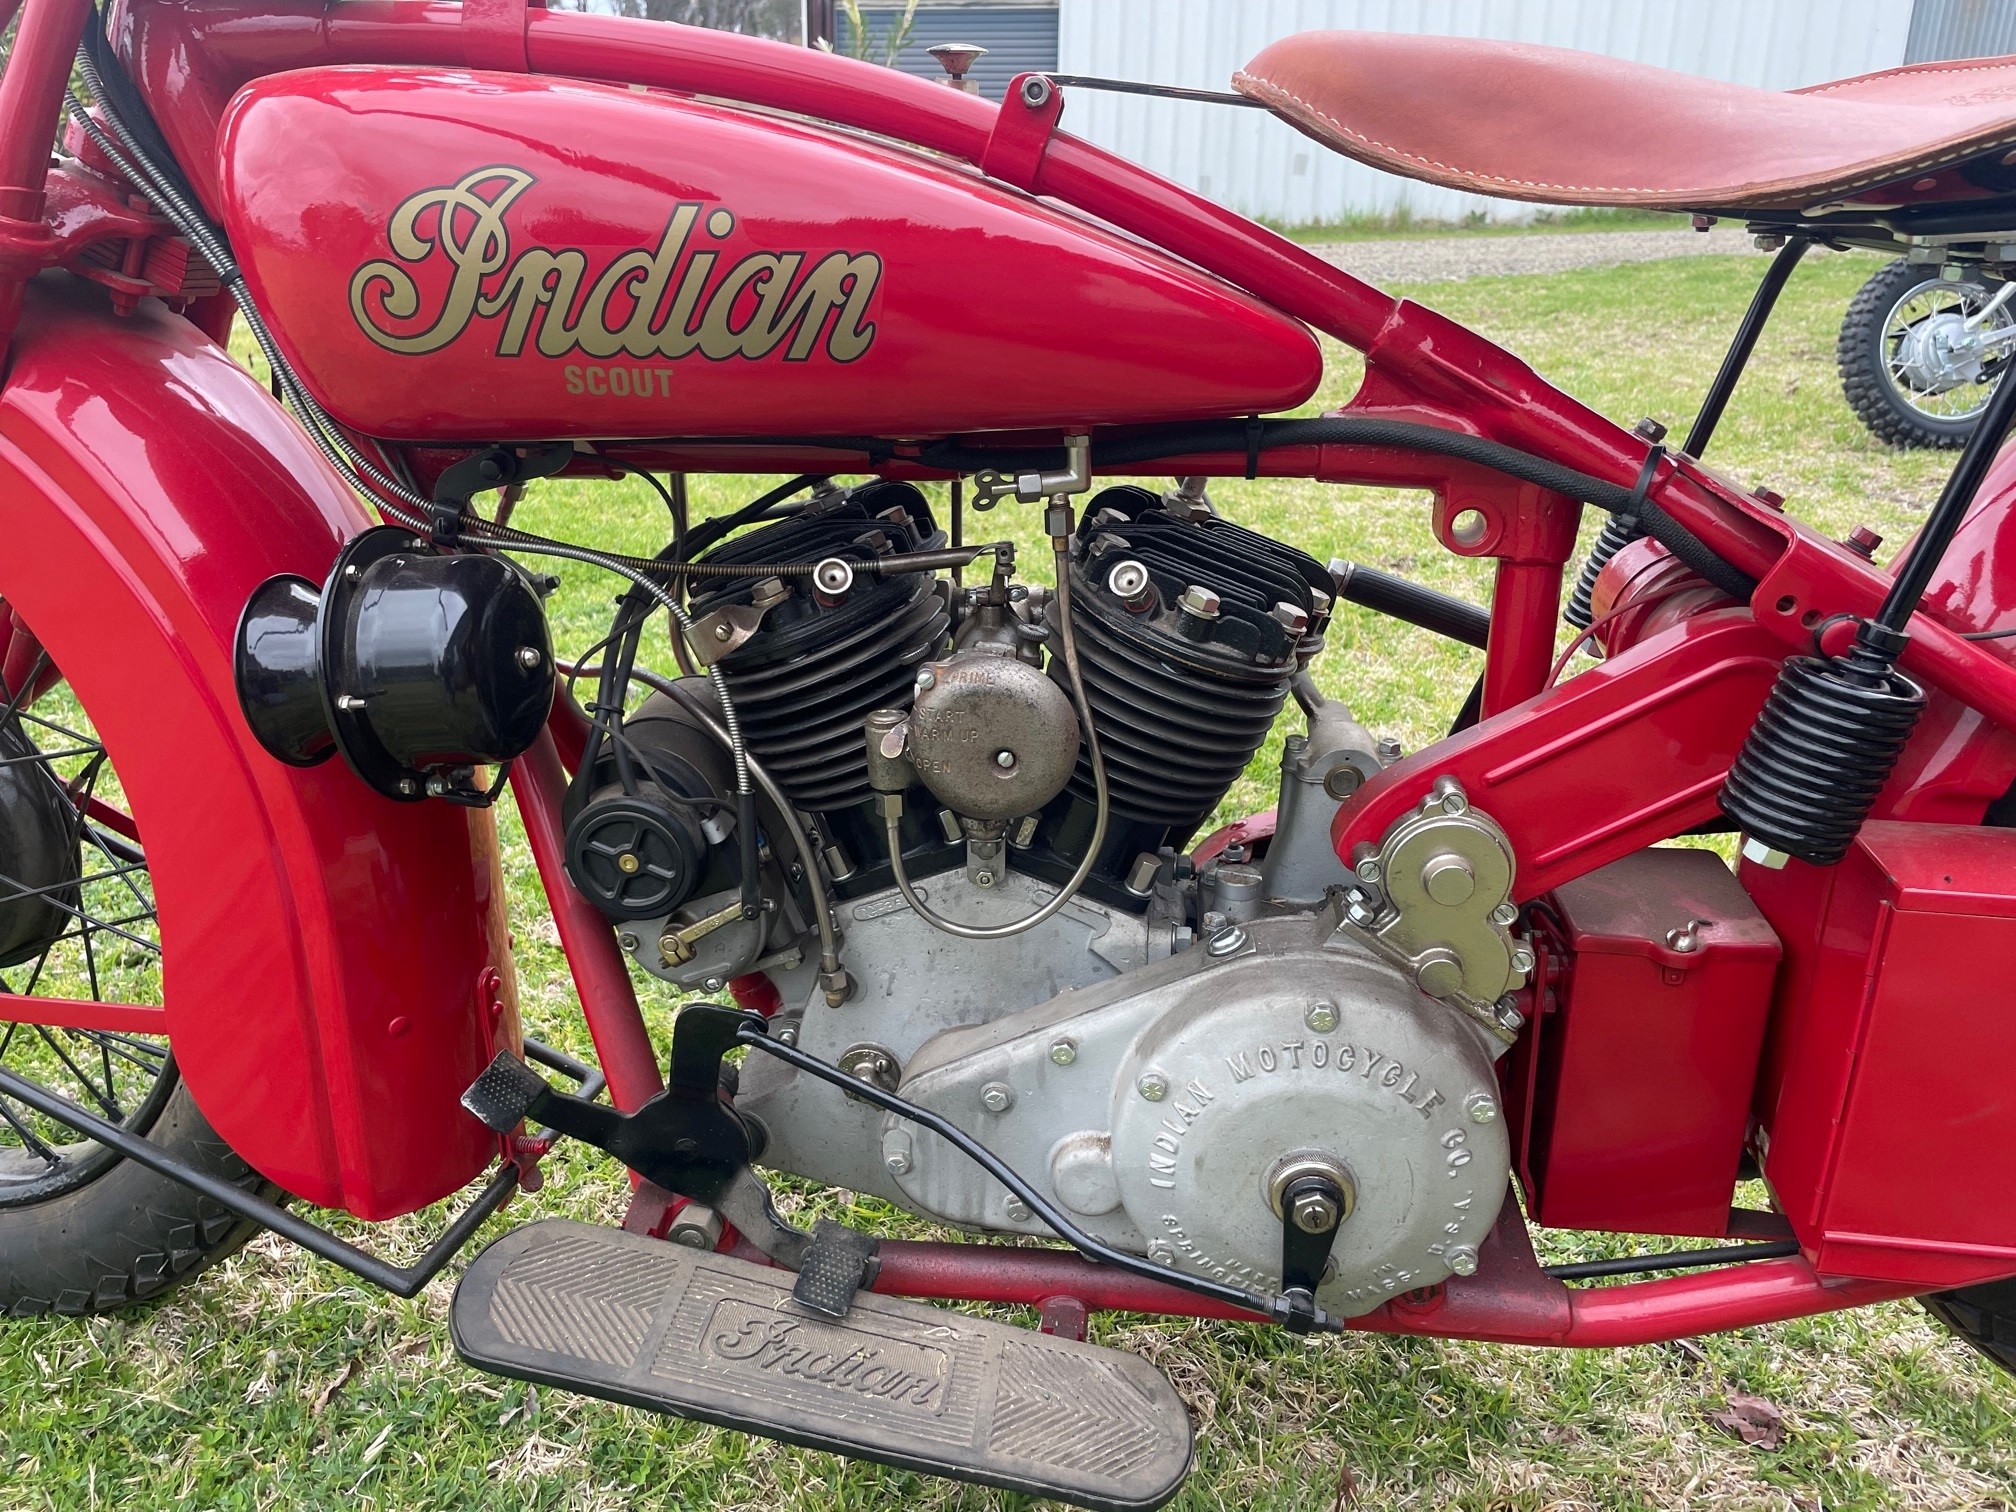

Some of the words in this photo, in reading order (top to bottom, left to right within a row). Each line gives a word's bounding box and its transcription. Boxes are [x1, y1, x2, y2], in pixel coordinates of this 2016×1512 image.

[347, 163, 883, 364] Indian
[565, 364, 674, 399] SCOUT
[950, 670, 995, 687] PRIME
[918, 708, 966, 725] START
[914, 725, 955, 743] WARM
[960, 730, 979, 743] UP
[915, 757, 951, 774] OPEN
[1149, 1076, 1215, 1189] INDIAN
[1225, 1039, 1446, 1120] MOTOCYCLE
[708, 1317, 941, 1406] Indian
